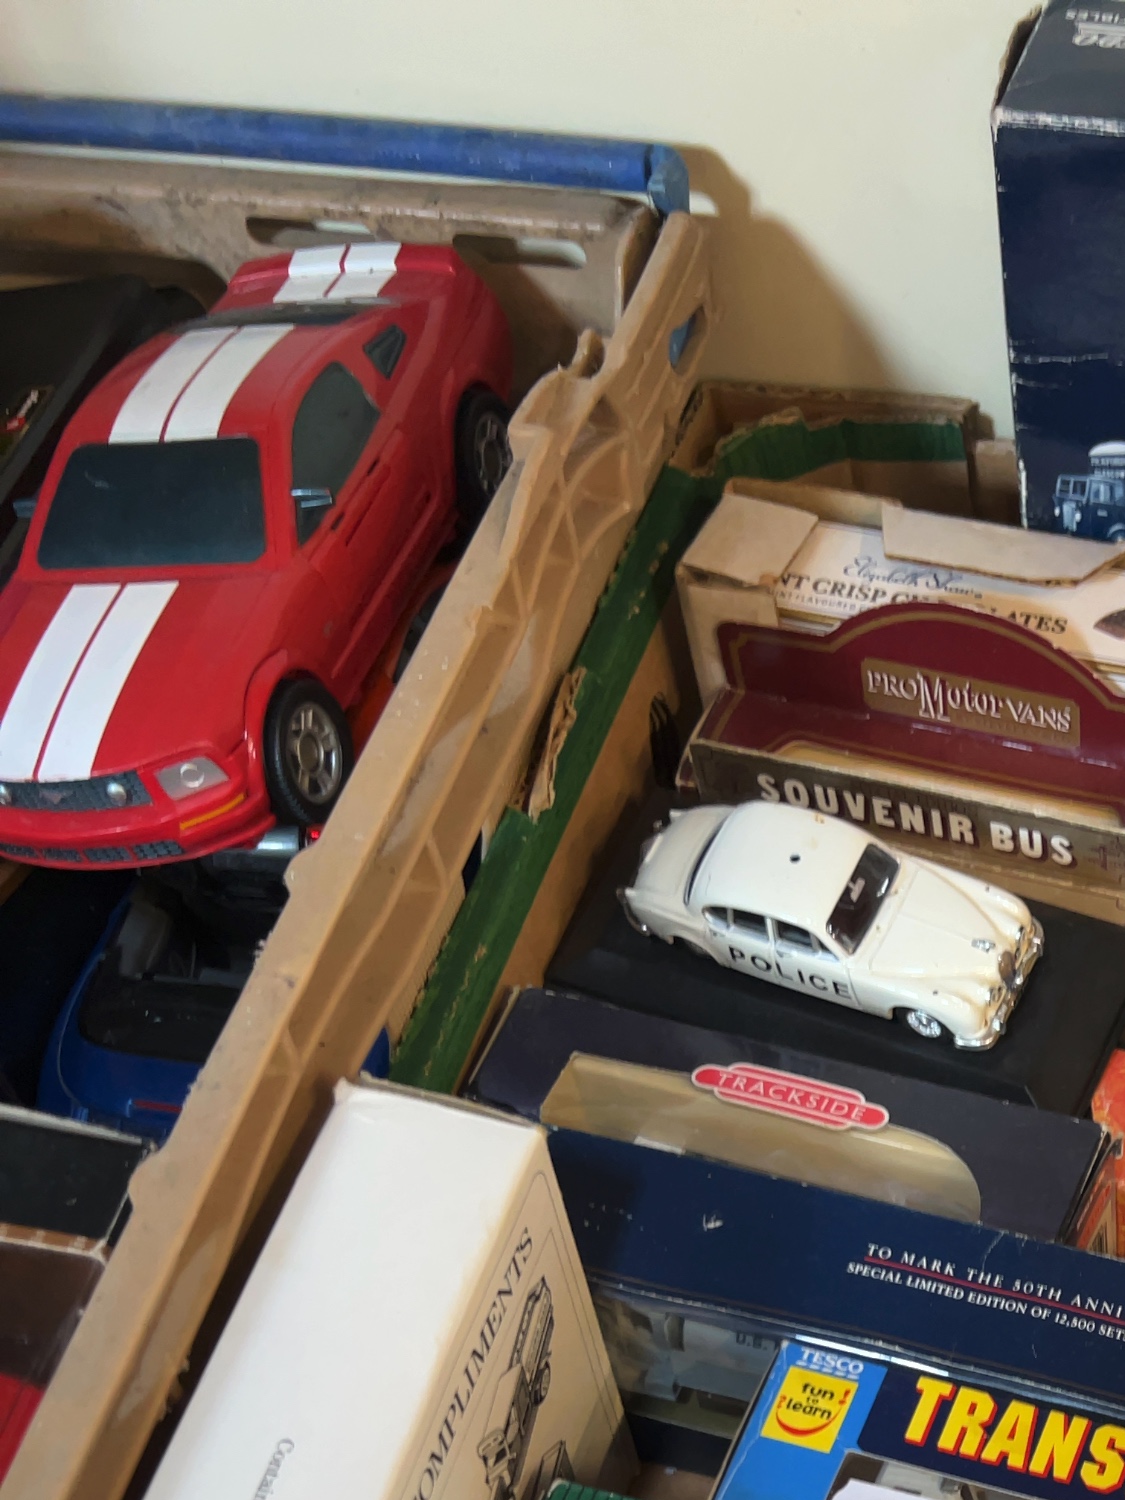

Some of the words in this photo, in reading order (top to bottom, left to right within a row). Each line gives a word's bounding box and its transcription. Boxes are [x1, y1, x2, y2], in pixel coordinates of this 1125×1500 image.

[812, 576, 888, 604] CRISP
[756, 772, 976, 846] SOUVENIR
[989, 820, 1074, 867] BUS
[728, 943, 853, 1000] POLICE
[716, 1071, 868, 1122] TRACKSIDE
[867, 1243, 892, 1260] TO
[901, 1251, 956, 1277] MARK
[967, 1266, 1003, 1289] THE
[1012, 1278, 1062, 1303] 50TH
[847, 1261, 903, 1285] SPECIAL
[906, 1275, 964, 1301] LIMITED
[967, 1291, 1028, 1315] EDITION
[1030, 1306, 1051, 1321] OF
[1054, 1311, 1095, 1334] 12,500
[800, 1347, 864, 1375] TESCO
[786, 1397, 833, 1421] learn
[801, 1382, 835, 1402] fun
[806, 1396, 819, 1405] to
